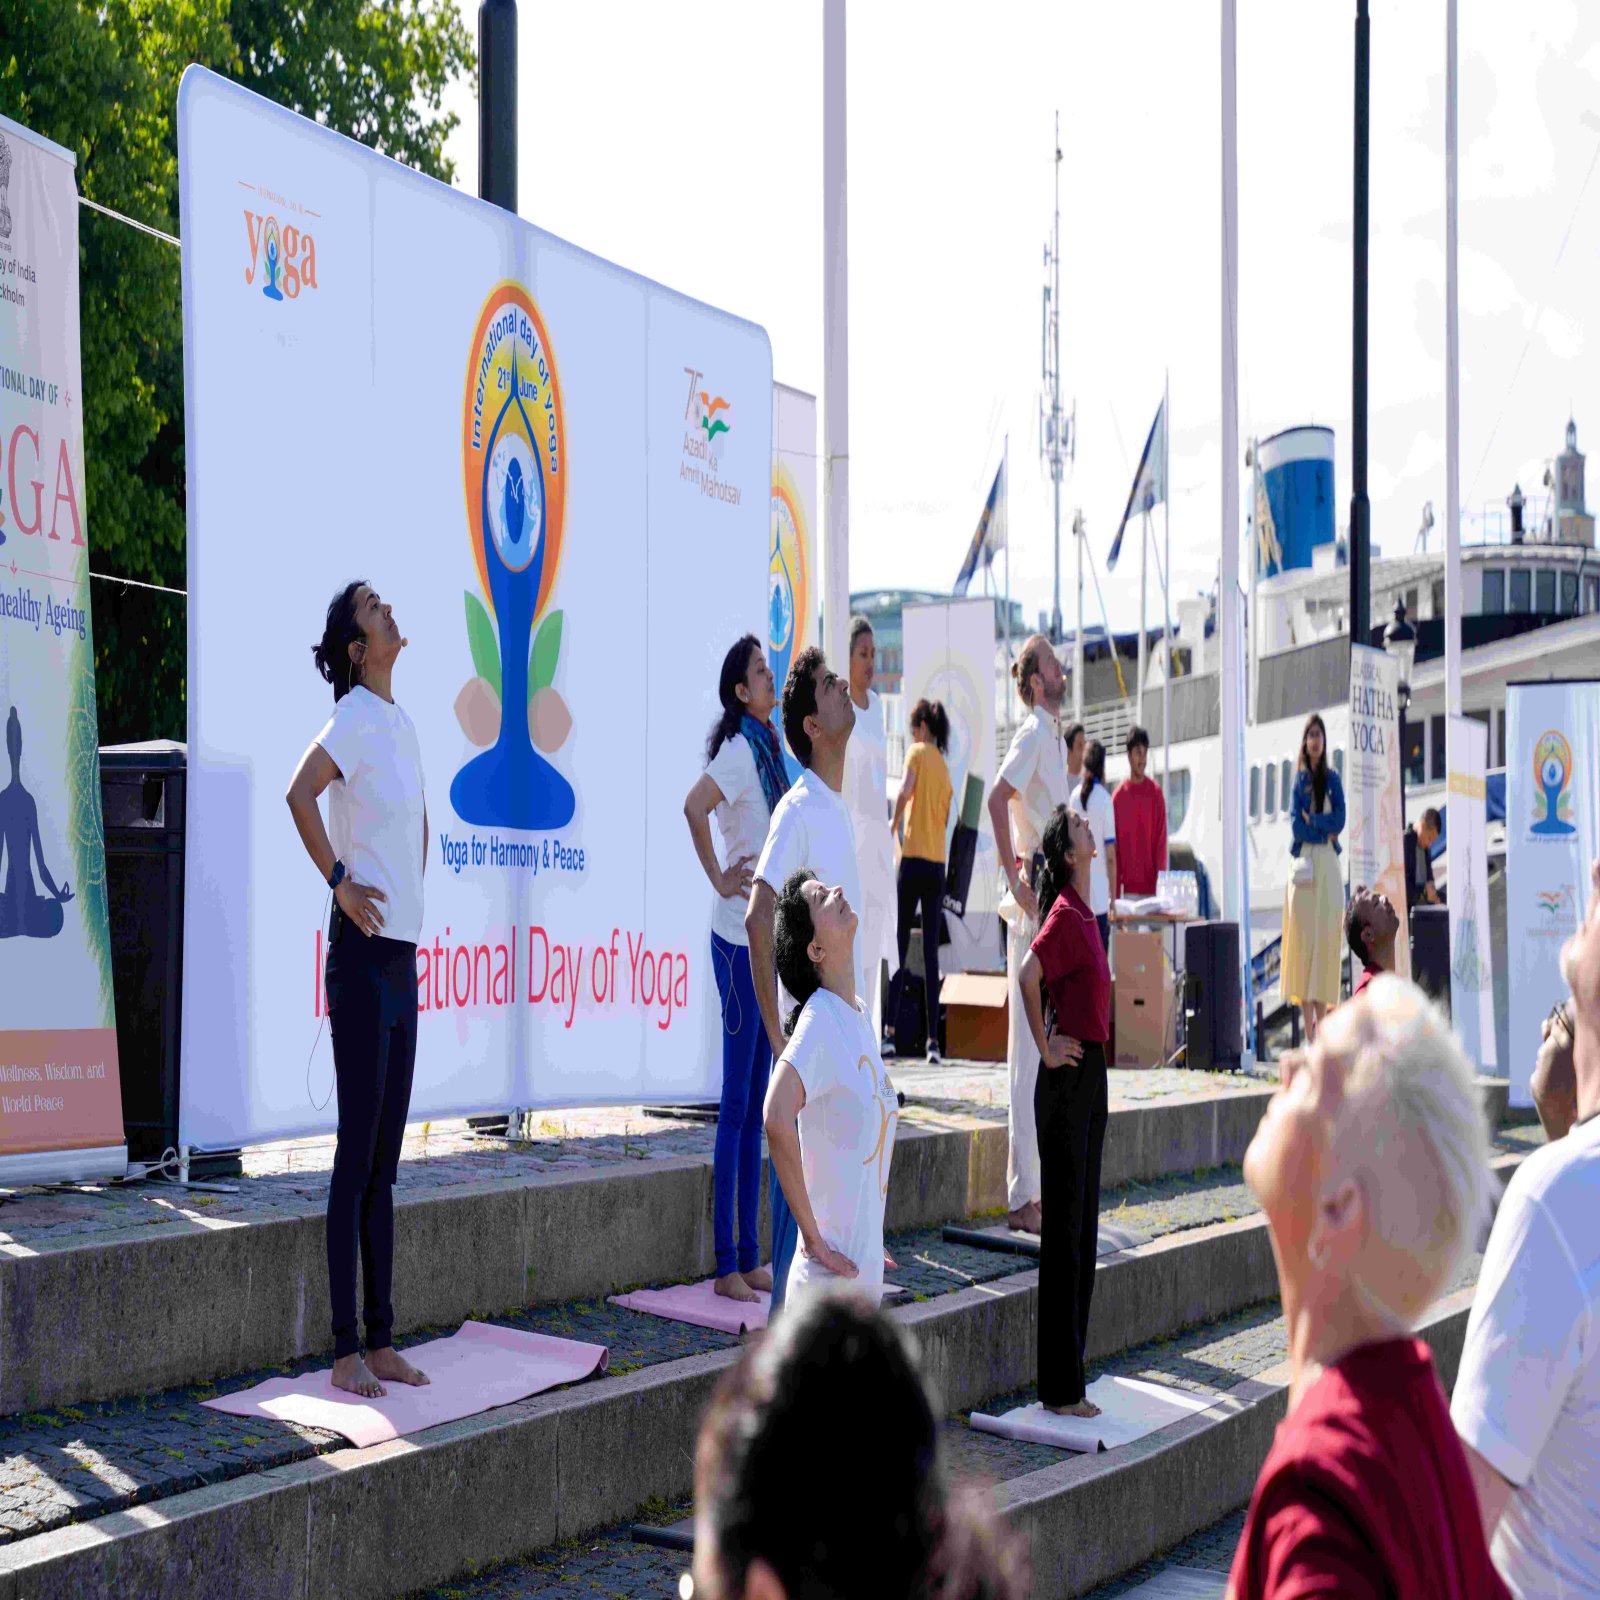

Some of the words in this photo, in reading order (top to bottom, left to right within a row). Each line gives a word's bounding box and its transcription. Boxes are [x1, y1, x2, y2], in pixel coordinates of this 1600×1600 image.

[8, 259, 16, 275] of
[17, 261, 36, 283] India
[520, 316, 539, 359] day
[0, 366, 27, 395] IONAL
[30, 376, 46, 402] DAY
[49, 383, 59, 406] OF
[472, 308, 517, 450] International
[519, 375, 538, 402] June
[539, 358, 550, 386] of
[544, 392, 558, 473] yoga
[683, 432, 707, 460] Azadi
[0, 423, 86, 547] GA
[45, 594, 86, 640] Ageing
[1352, 685, 1394, 721] HATHA
[1352, 722, 1385, 755] YOGA
[440, 834, 468, 873] Yoga
[471, 834, 488, 866] for
[490, 835, 540, 876] Harmony
[542, 839, 550, 868] &
[553, 839, 585, 871] Peace
[528, 926, 583, 1028] Day
[592, 928, 619, 1002] of
[627, 930, 689, 1030] Yoga
[87, 1061, 105, 1079] and
[2, 1095, 32, 1113] World
[34, 1094, 64, 1112] Peace
